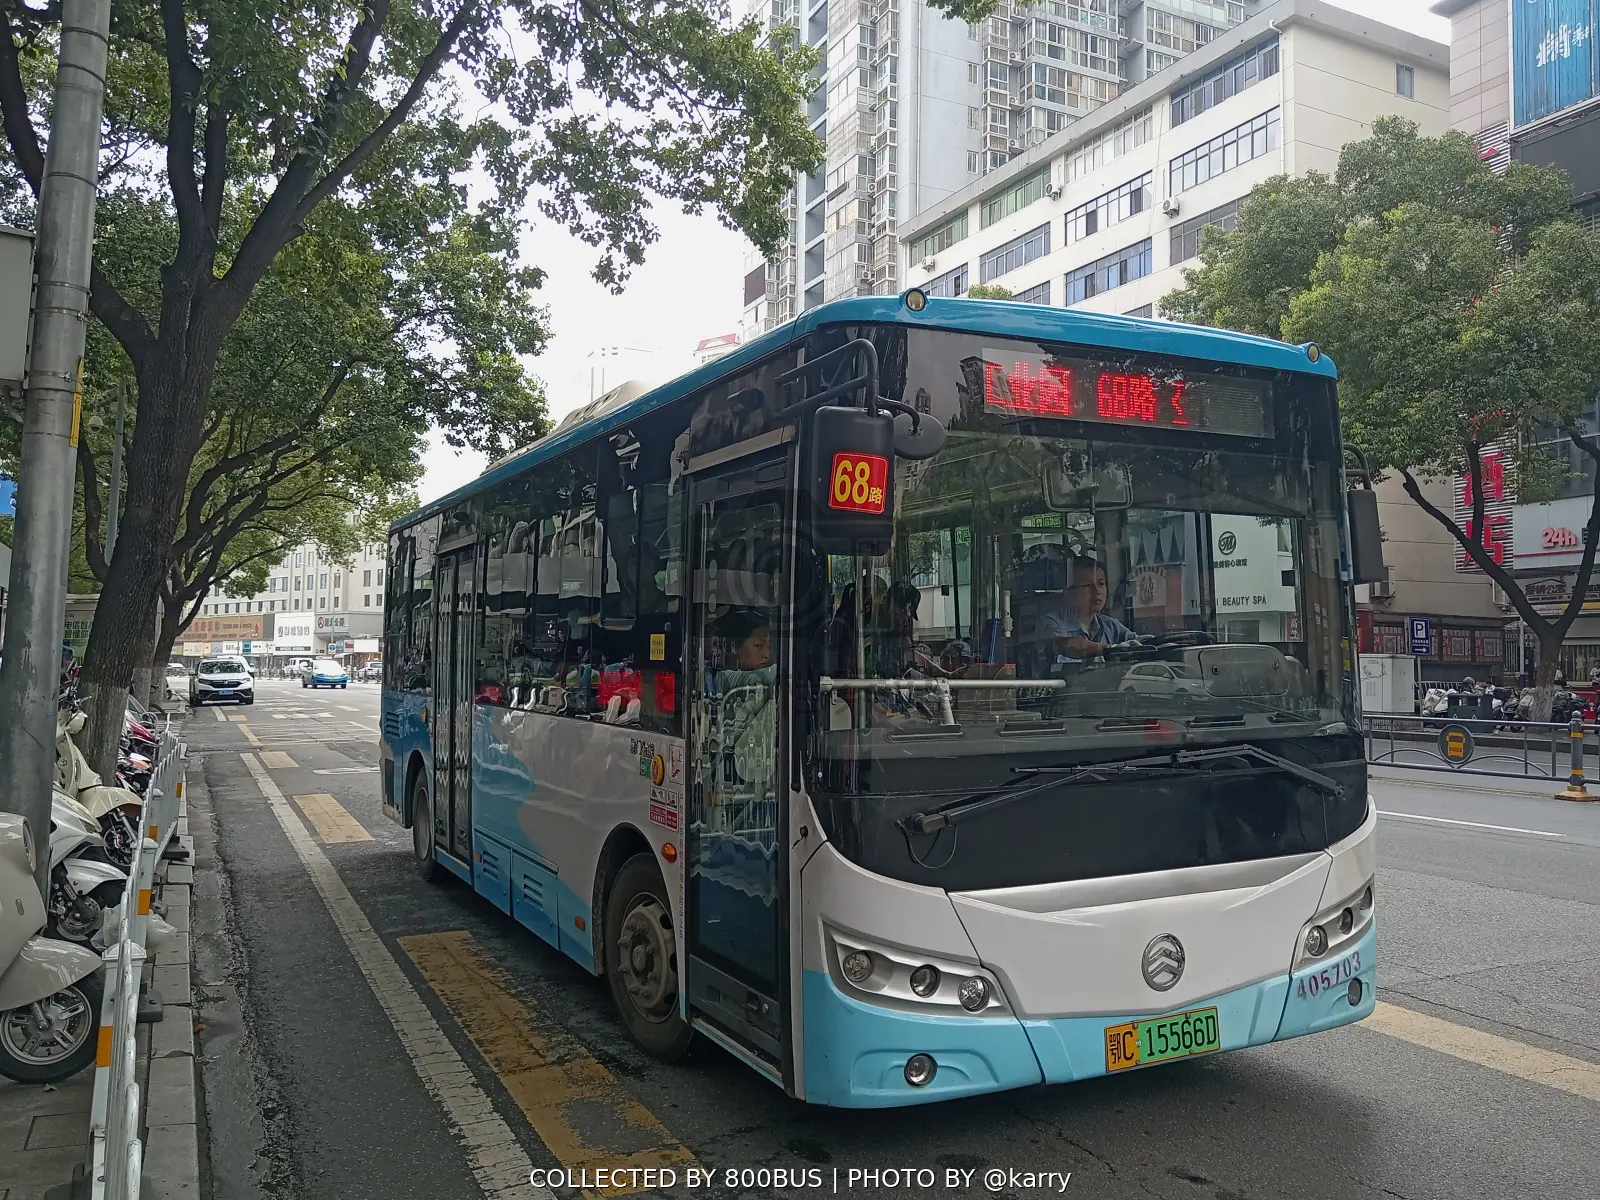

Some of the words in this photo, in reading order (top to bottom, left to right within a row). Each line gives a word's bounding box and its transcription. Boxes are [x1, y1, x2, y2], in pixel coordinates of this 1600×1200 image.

[1542, 527, 1578, 548] 24h
[1222, 596, 1250, 606] BEAUTY
[1252, 595, 1267, 605] SPA
[1415, 622, 1424, 637] P
[1297, 950, 1361, 1000] 405703
